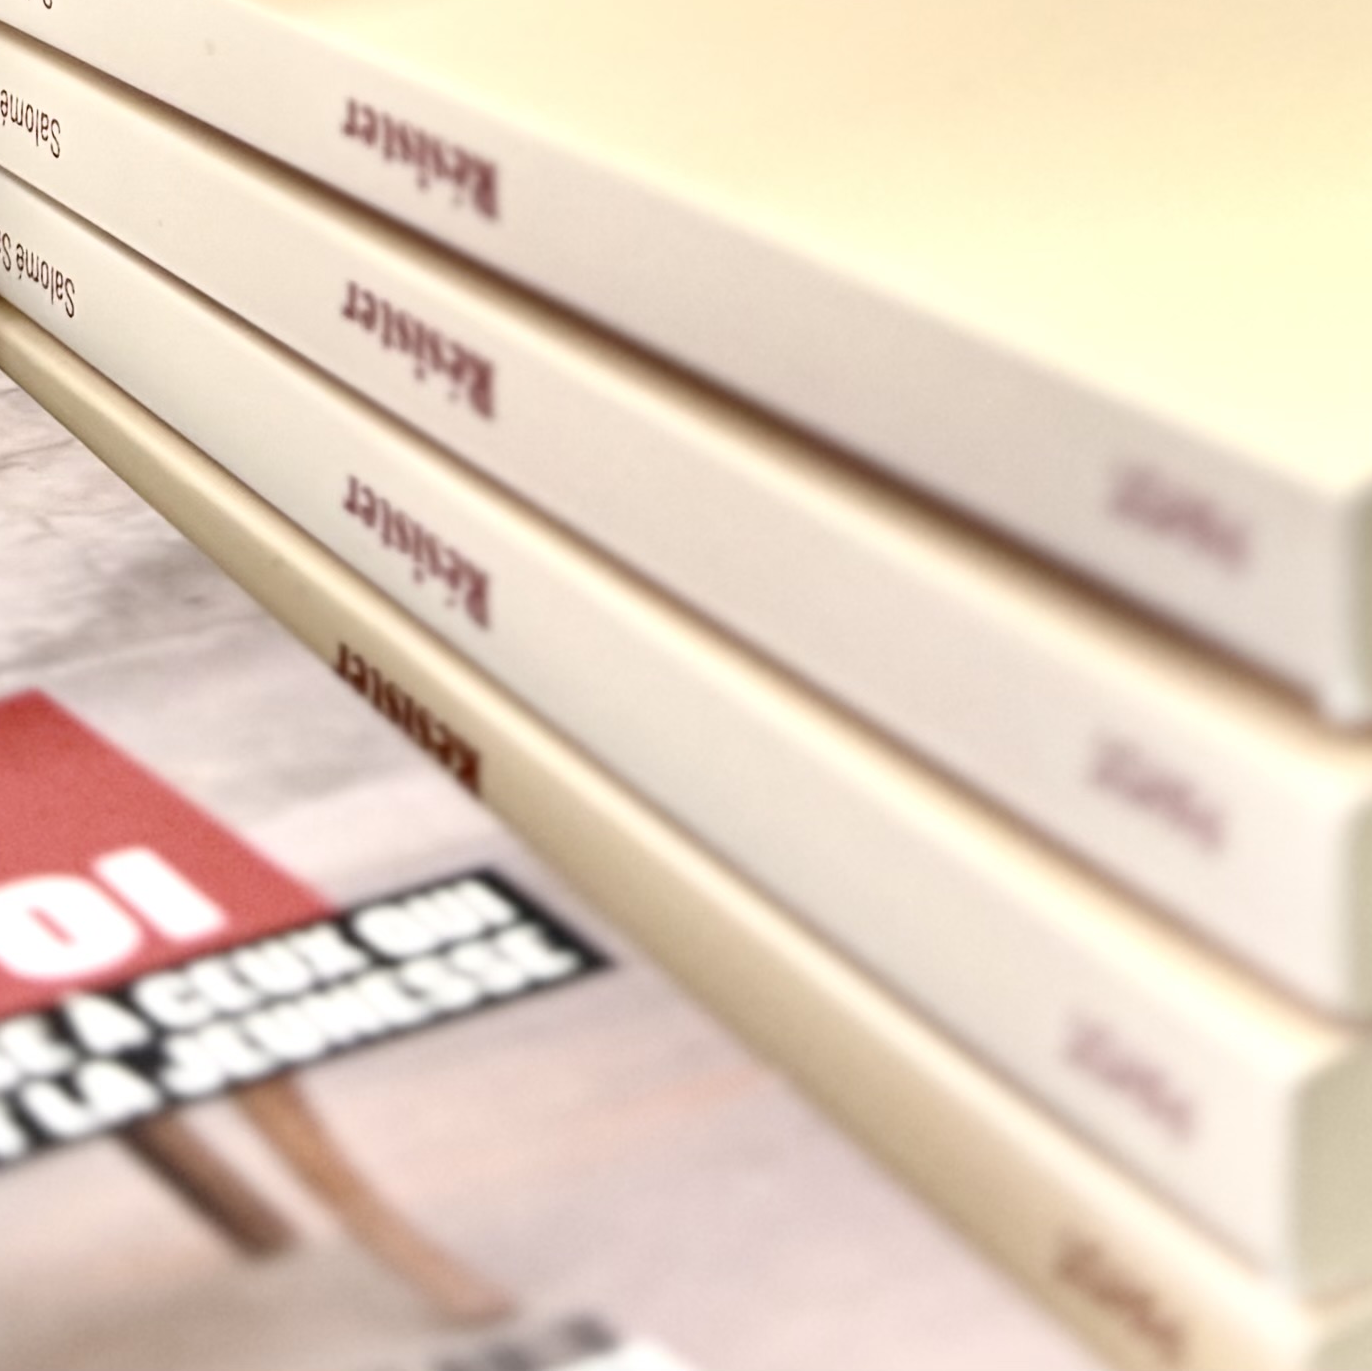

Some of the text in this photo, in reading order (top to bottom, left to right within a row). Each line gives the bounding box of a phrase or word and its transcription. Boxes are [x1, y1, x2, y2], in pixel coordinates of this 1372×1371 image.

[0, 89, 61, 159] Salomé
[340, 94, 501, 223] Résister
[16, 243, 76, 318] Salomé
[340, 280, 497, 422] Résister
[341, 473, 492, 632] Résister
[131, 921, 374, 1028] CEUX
[350, 876, 519, 957] QUI
[21, 1060, 163, 1143] LA
[155, 923, 581, 1098] JEUNESSE
